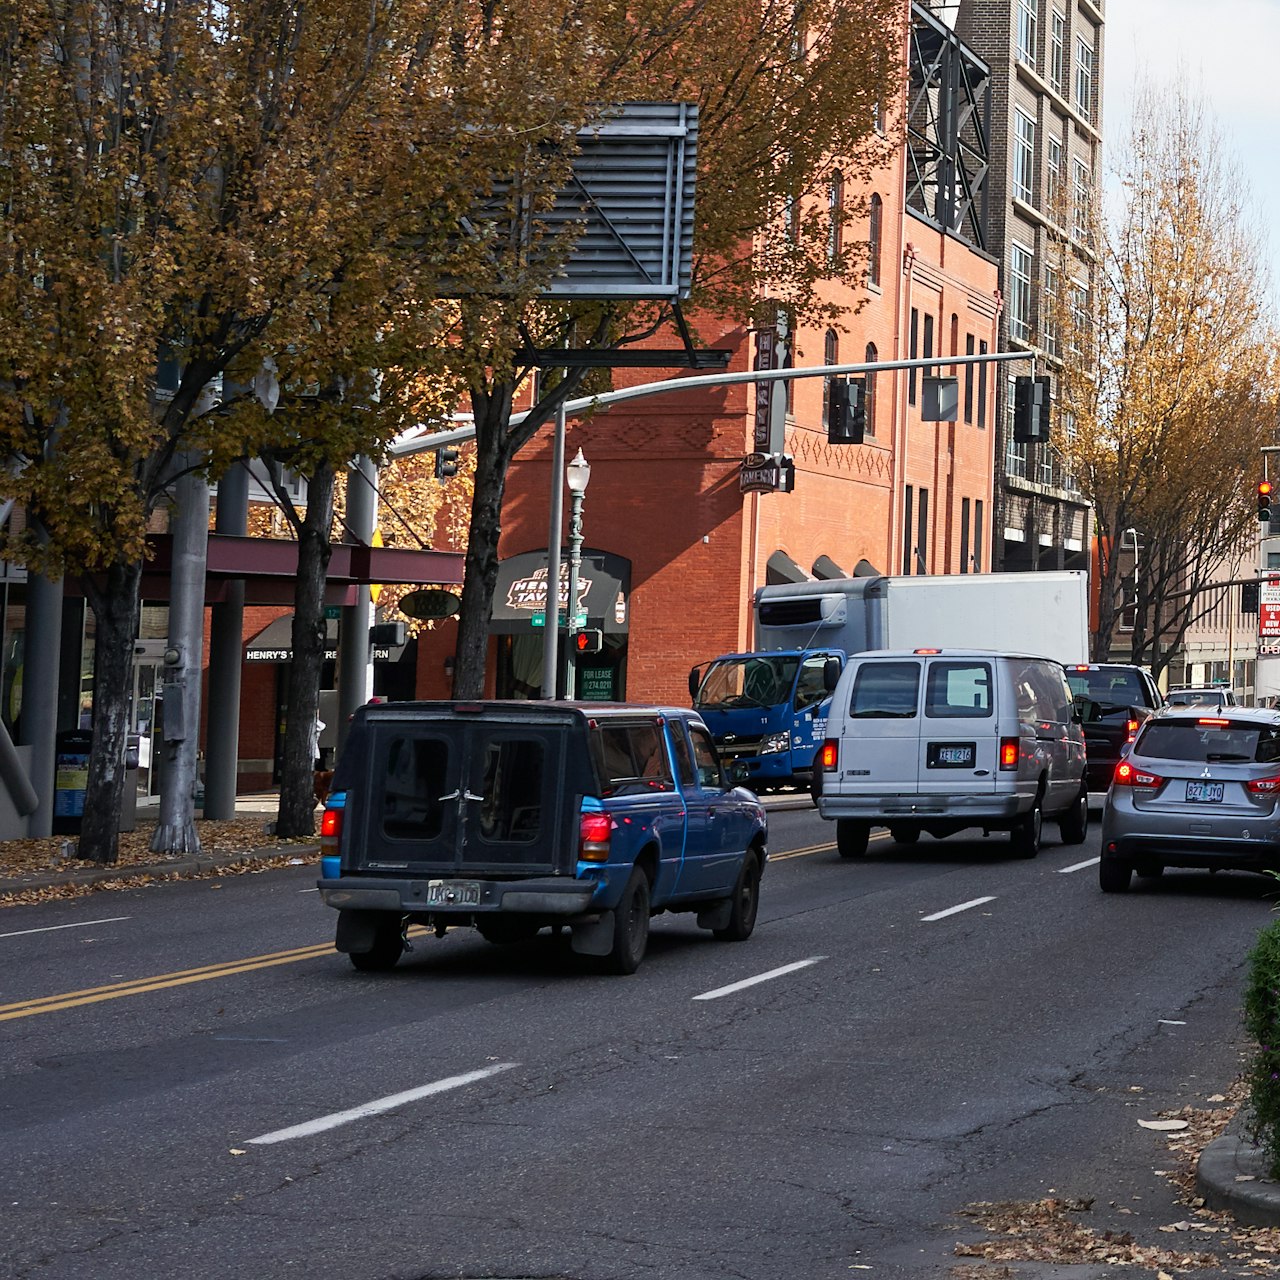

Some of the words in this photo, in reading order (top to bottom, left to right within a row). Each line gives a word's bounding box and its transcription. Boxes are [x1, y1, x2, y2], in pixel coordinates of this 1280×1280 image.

[1265, 604, 1280, 612] USED
[246, 650, 287, 660] HENRY'S
[372, 650, 388, 658] ERN
[583, 670, 594, 679] FOR
[595, 670, 612, 679] LEASE
[940, 749, 953, 760] XET
[957, 749, 971, 760] 216
[1188, 786, 1202, 796] 827
